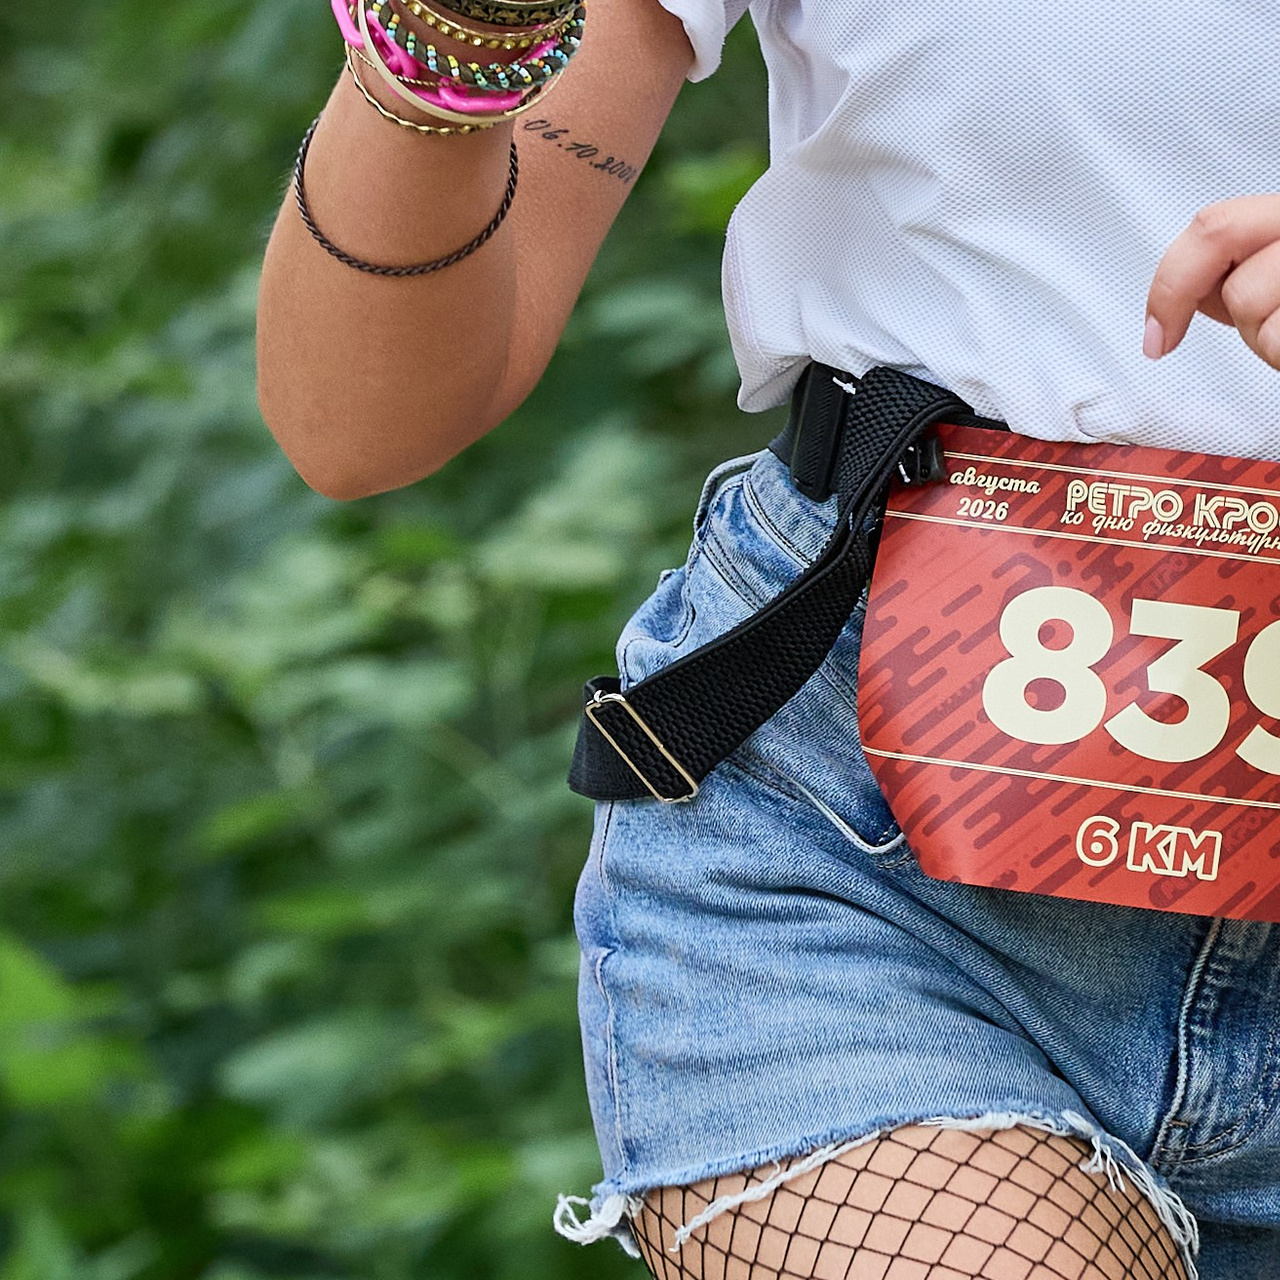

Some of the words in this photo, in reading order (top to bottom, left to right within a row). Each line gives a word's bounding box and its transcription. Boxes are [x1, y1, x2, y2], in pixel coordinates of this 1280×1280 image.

[950, 467, 1041, 495] августа
[956, 497, 1009, 522] 2026
[1067, 479, 1183, 522] РЕТРО
[1060, 510, 1084, 526] ко
[1092, 516, 1134, 535] дню
[1076, 816, 1119, 868] 6
